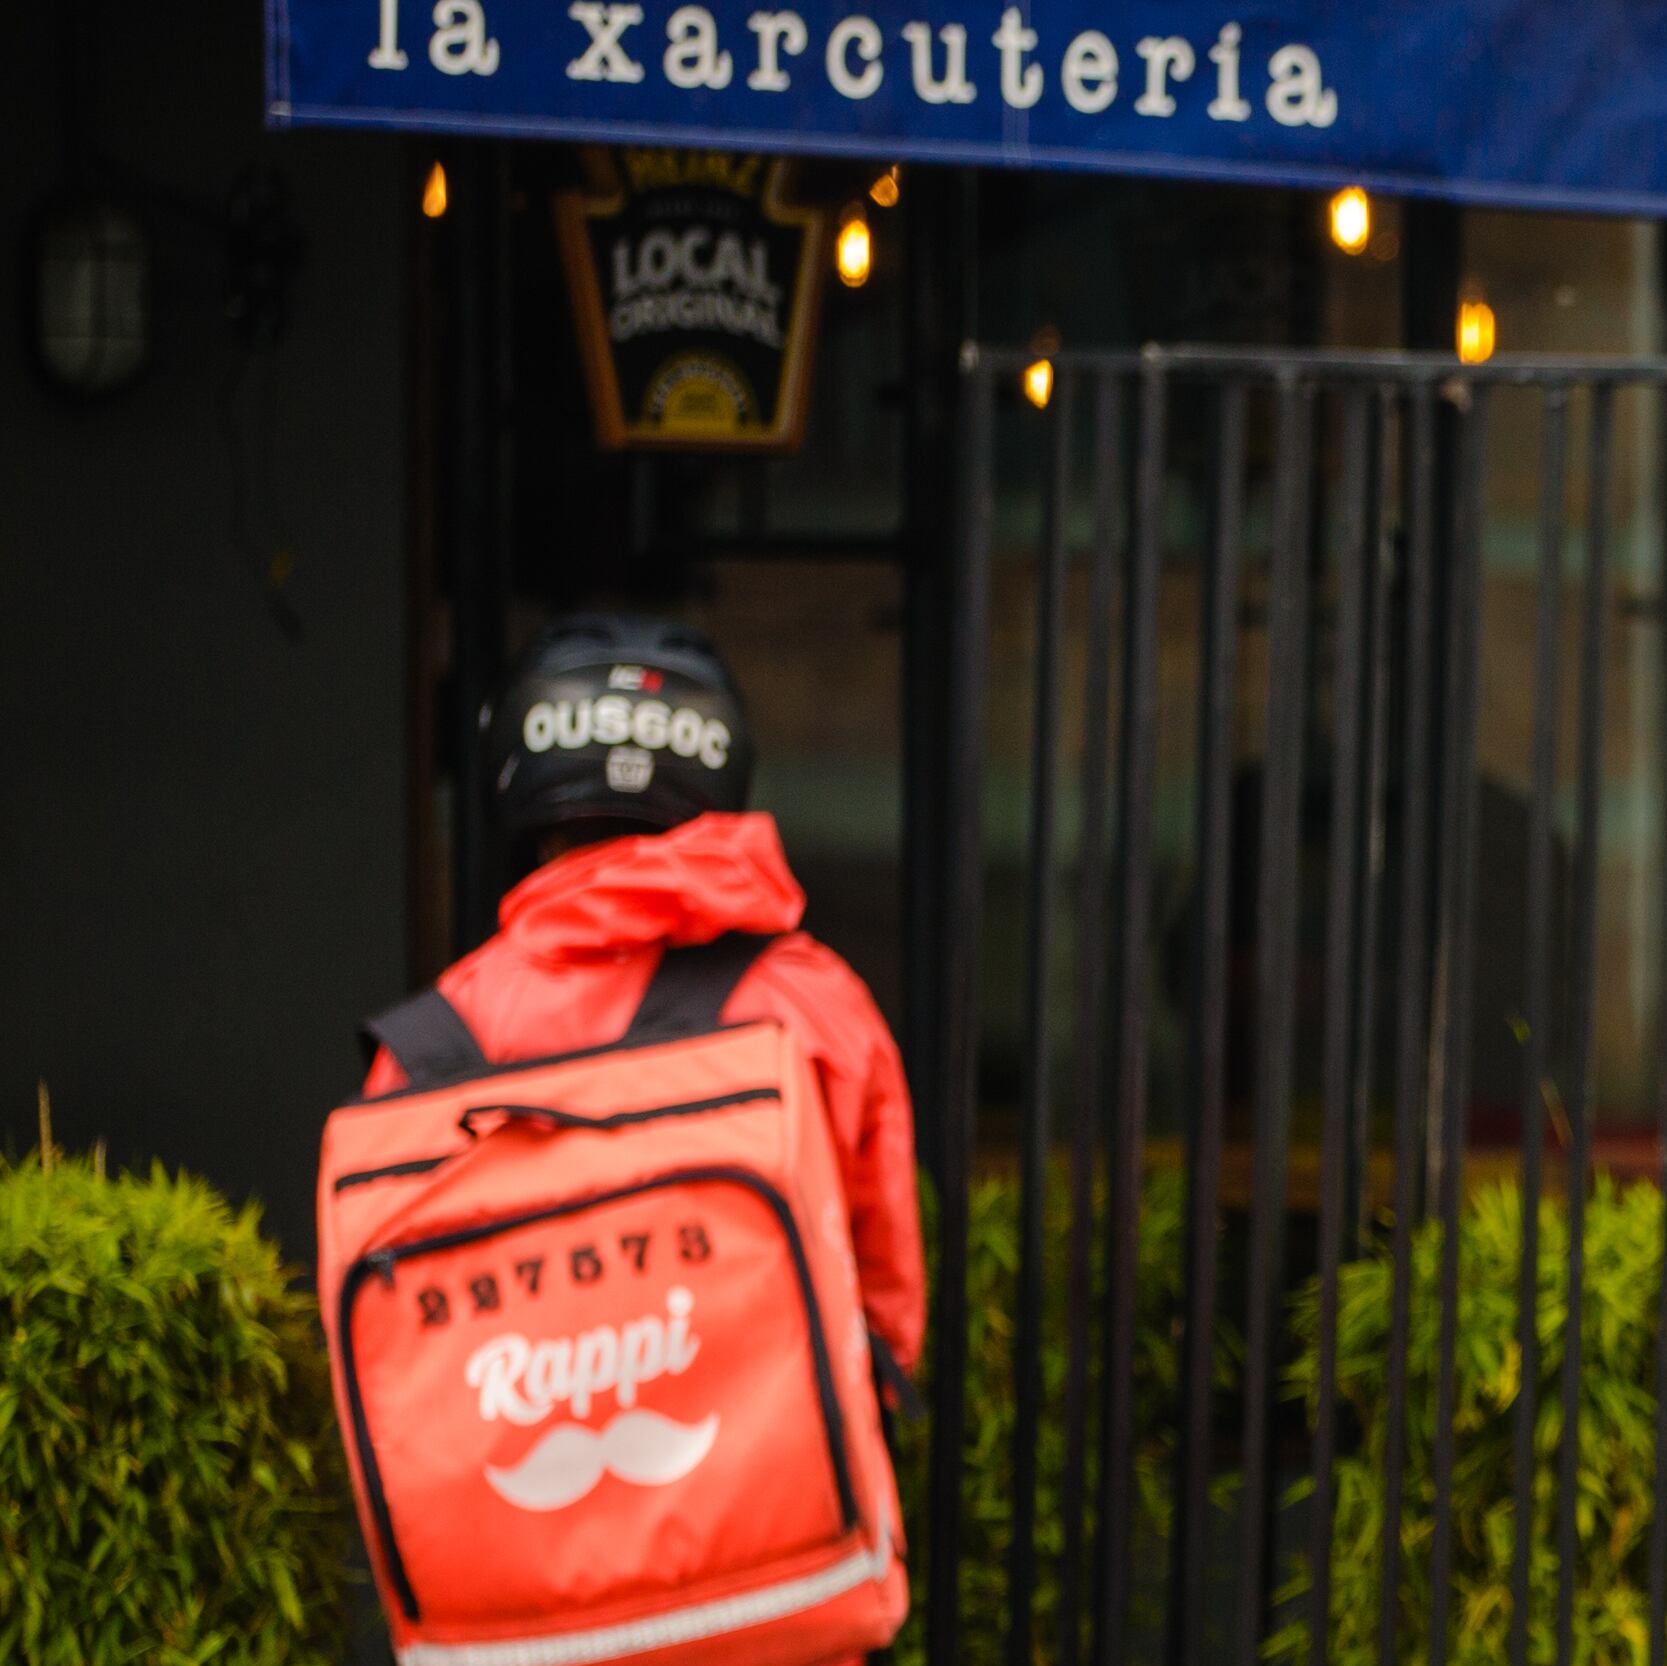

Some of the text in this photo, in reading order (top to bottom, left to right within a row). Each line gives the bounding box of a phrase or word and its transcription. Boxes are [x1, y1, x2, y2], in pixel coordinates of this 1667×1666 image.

[367, 0, 501, 77] la
[612, 232, 782, 304] LOCAL
[464, 1284, 702, 1426] Rappi
